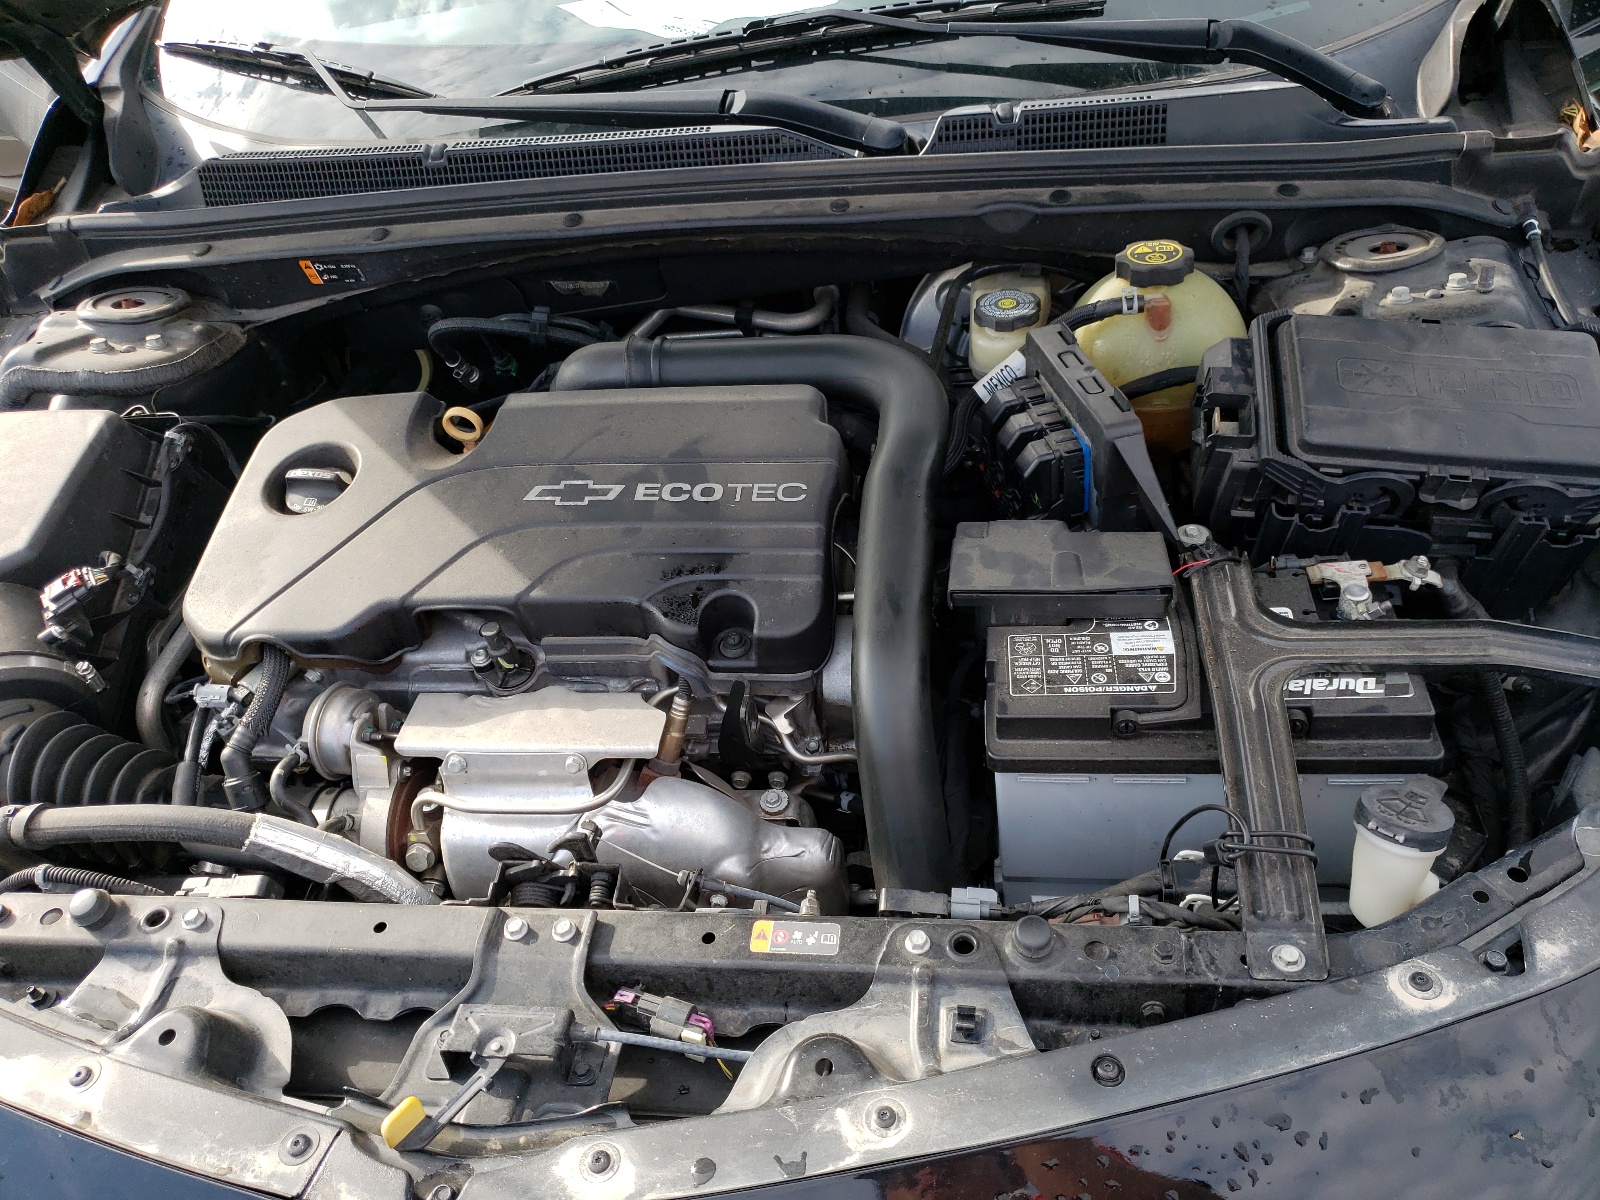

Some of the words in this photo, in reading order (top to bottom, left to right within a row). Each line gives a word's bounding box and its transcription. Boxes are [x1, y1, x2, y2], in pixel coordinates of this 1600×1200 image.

[982, 364, 1018, 396] MEXICO
[289, 469, 334, 478] dexos
[634, 482, 808, 502] ECOTEC
[1283, 678, 1384, 694] Durala
